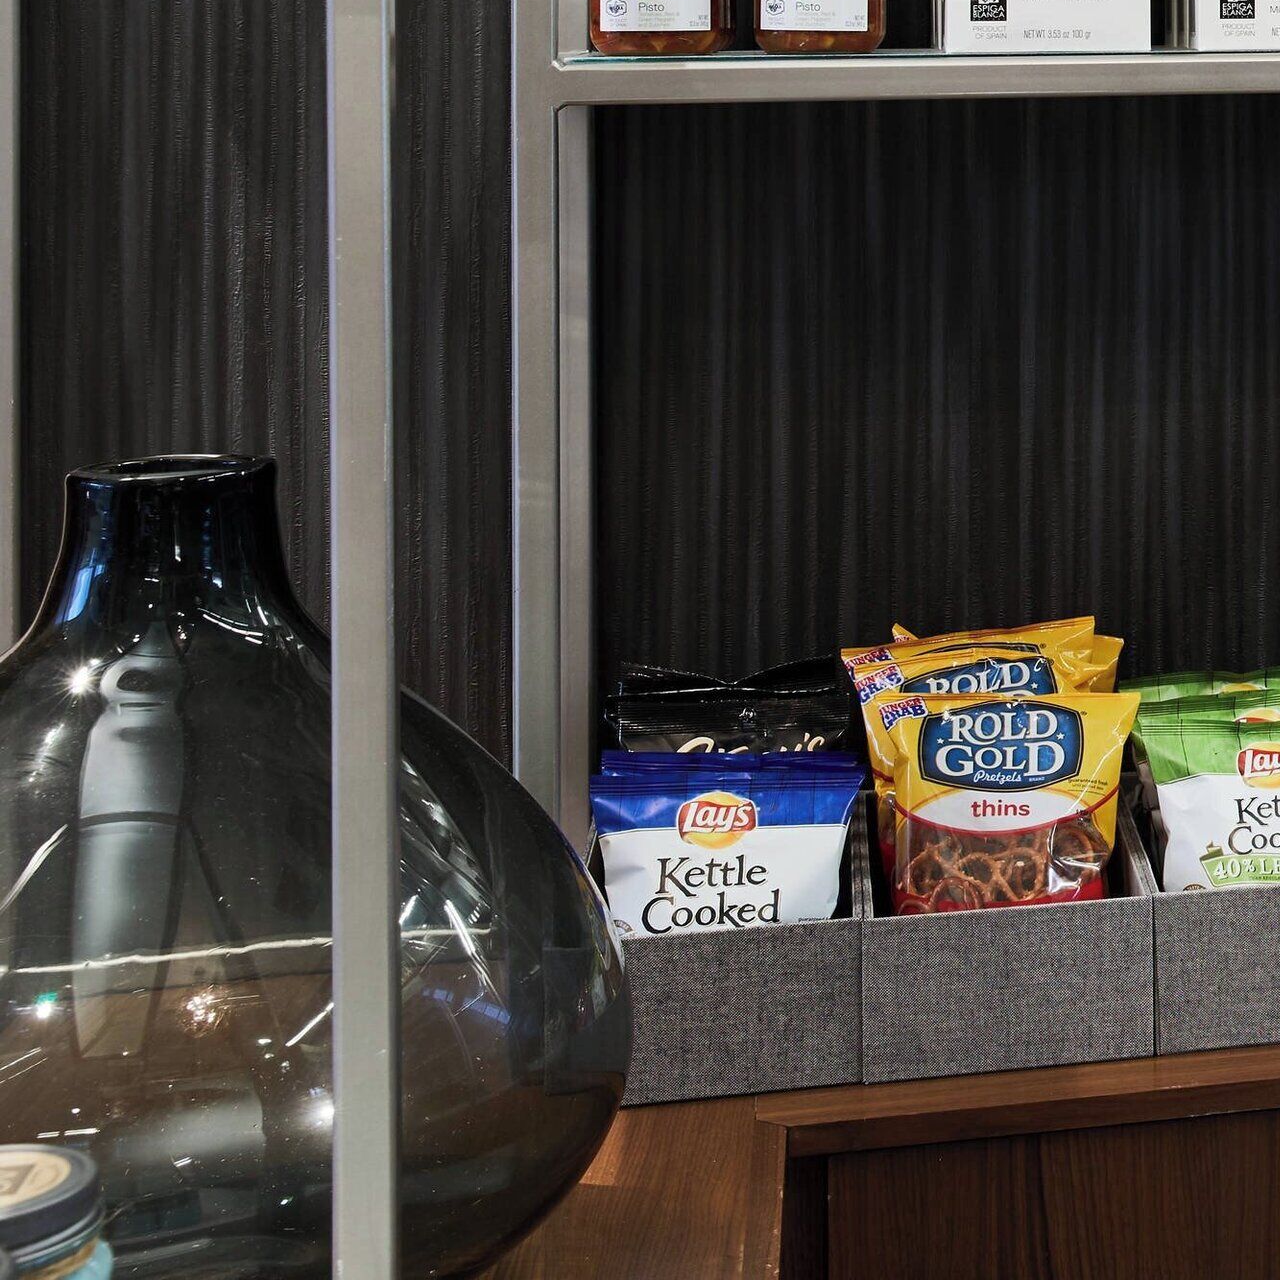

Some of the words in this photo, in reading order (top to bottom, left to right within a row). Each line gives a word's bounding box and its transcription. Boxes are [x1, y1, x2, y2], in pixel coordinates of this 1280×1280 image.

[638, 2, 665, 12] Pisto
[796, 1, 821, 12] Pisto
[972, 4, 1005, 12] ESPIGA
[1222, 3, 1253, 11] ESPIGA
[1047, 30, 1062, 39] 3.53
[1072, 29, 1083, 39] 100
[947, 710, 1059, 746] ROLD
[935, 741, 1065, 777] GOLD
[973, 770, 1022, 785] Pretzels
[682, 801, 752, 833] Lay's
[971, 799, 1030, 818] thins
[655, 855, 767, 897] Kettle
[1213, 857, 1257, 880] 40%
[641, 888, 781, 935] Cooked
